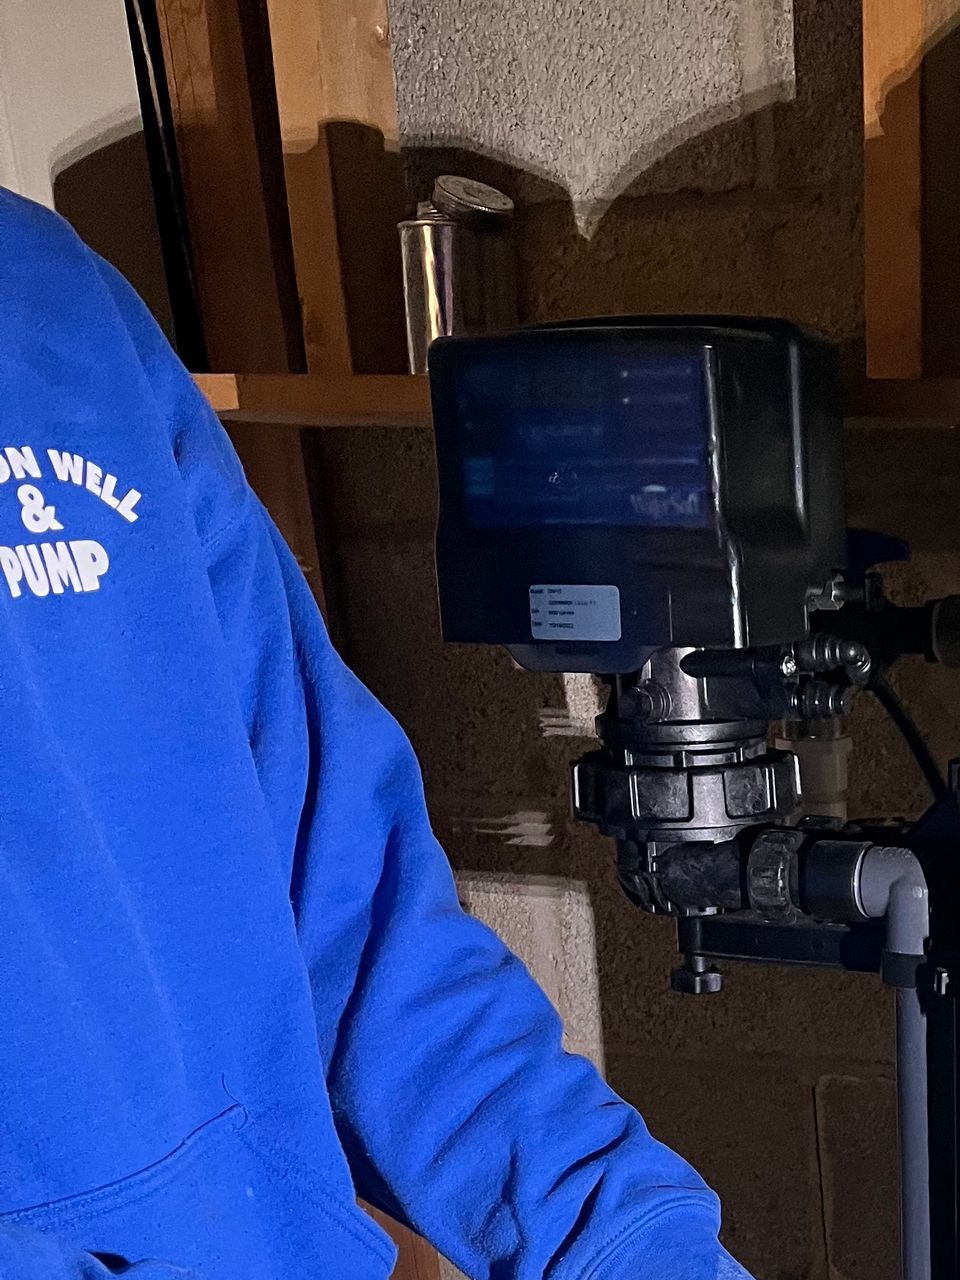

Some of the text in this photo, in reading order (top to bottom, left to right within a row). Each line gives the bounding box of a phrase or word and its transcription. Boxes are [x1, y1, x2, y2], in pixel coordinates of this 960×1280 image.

[17, 484, 65, 533] &
[47, 448, 142, 523] WELL
[0, 539, 110, 598] PUMP
